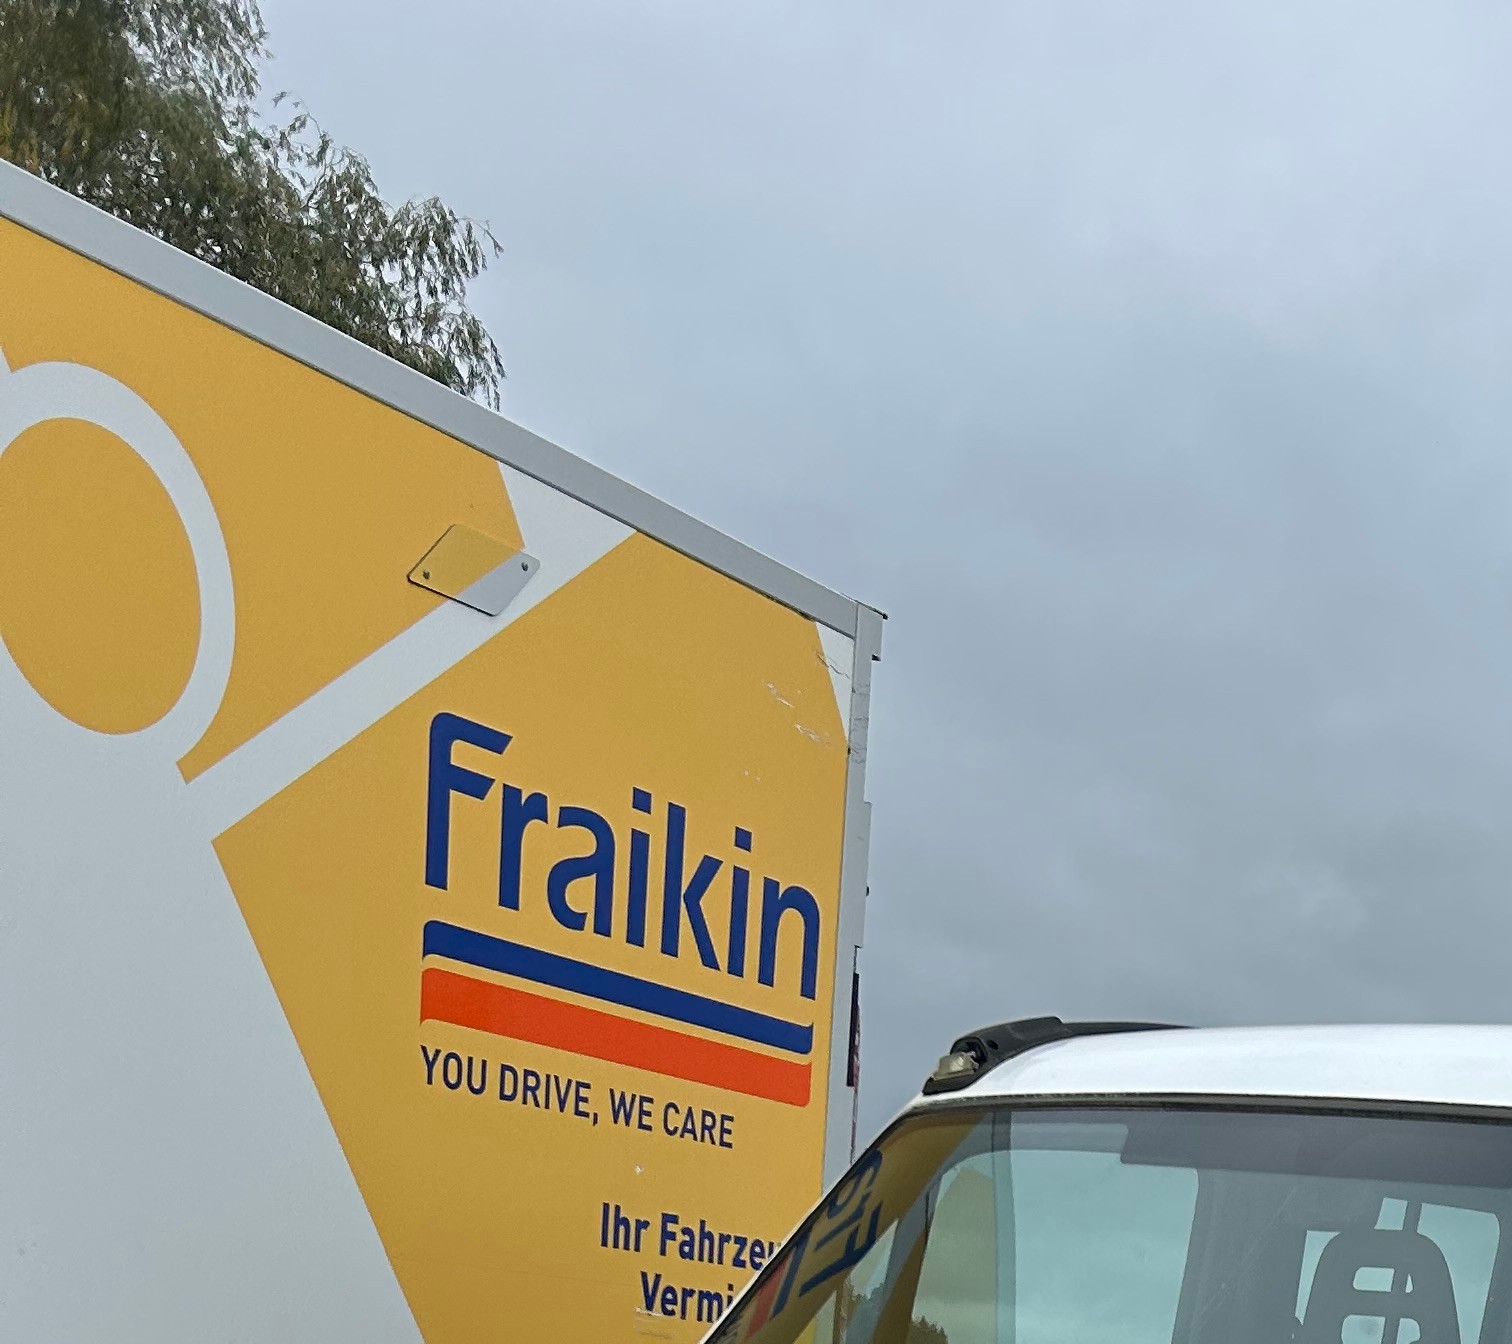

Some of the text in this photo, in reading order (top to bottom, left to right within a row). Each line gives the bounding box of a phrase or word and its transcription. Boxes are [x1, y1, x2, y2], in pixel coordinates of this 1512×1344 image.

[424, 712, 821, 1001] Fraikin
[419, 1044, 735, 1149] YOU DRIVE, WE CARE
[600, 1202, 650, 1252] Ihr
